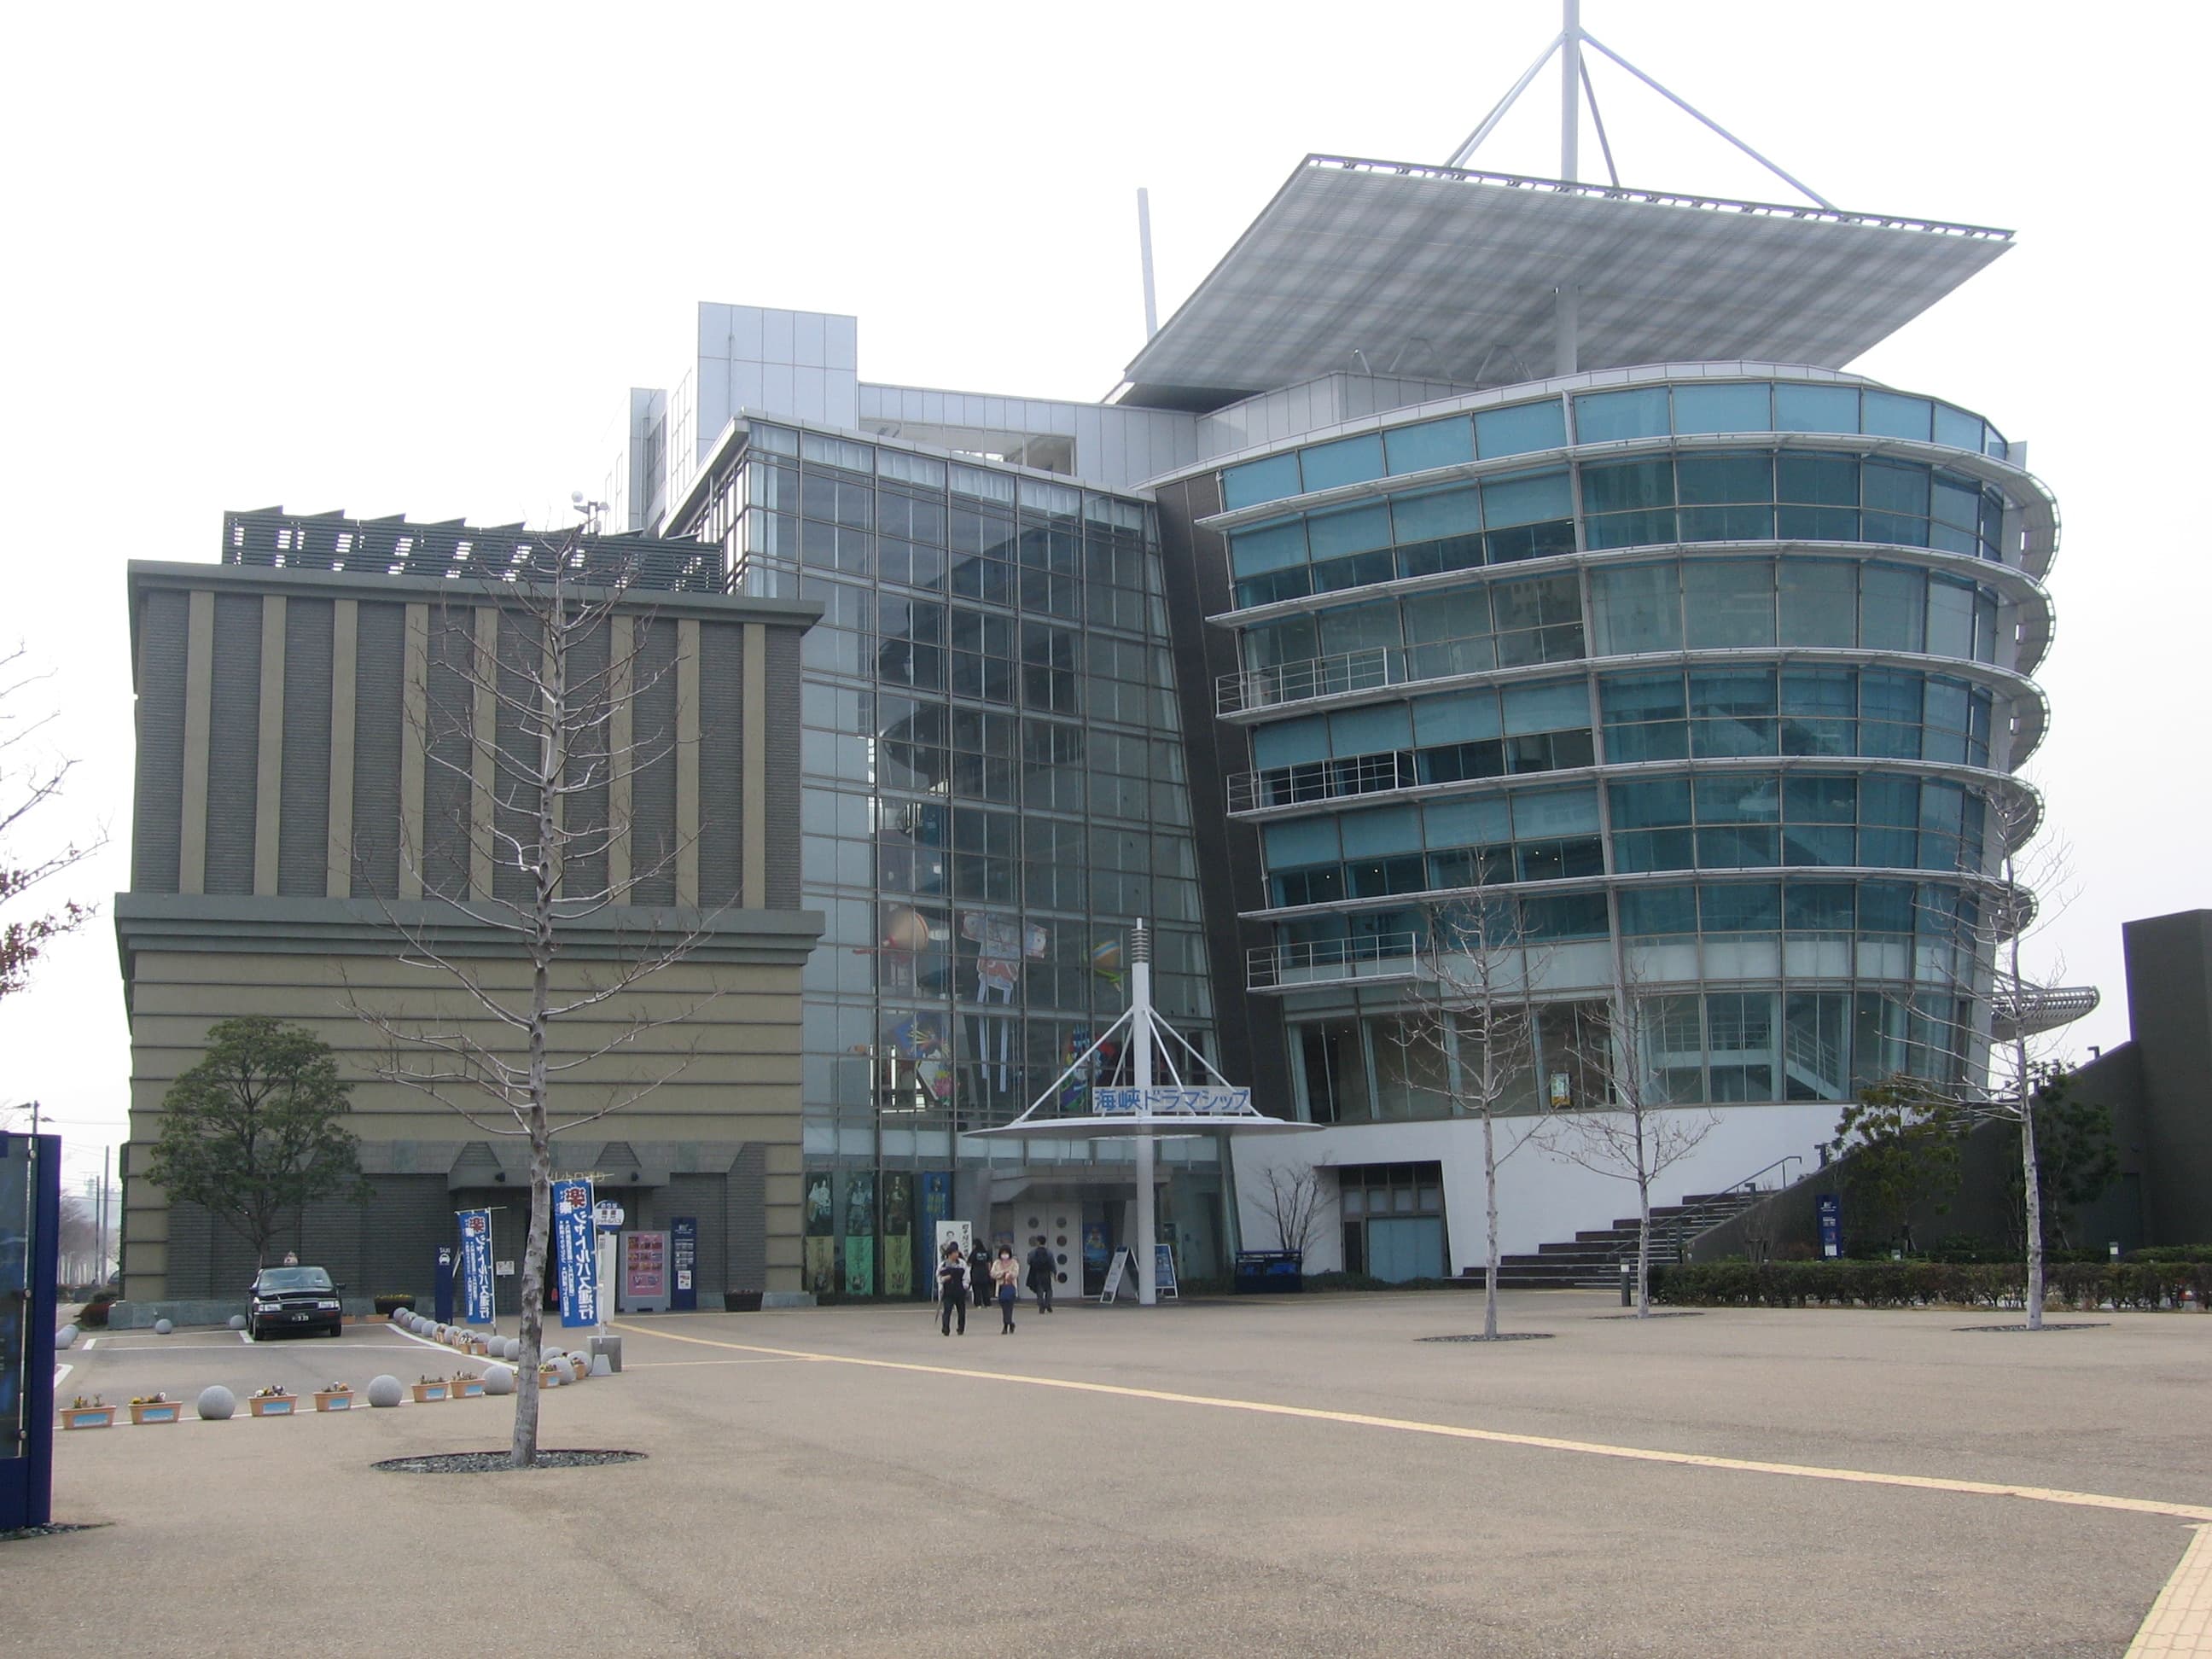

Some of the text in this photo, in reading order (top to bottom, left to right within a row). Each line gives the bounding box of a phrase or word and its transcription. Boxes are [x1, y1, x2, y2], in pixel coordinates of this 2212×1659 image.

[1094, 1088, 1249, 1111] 海峡ドラマシップ
